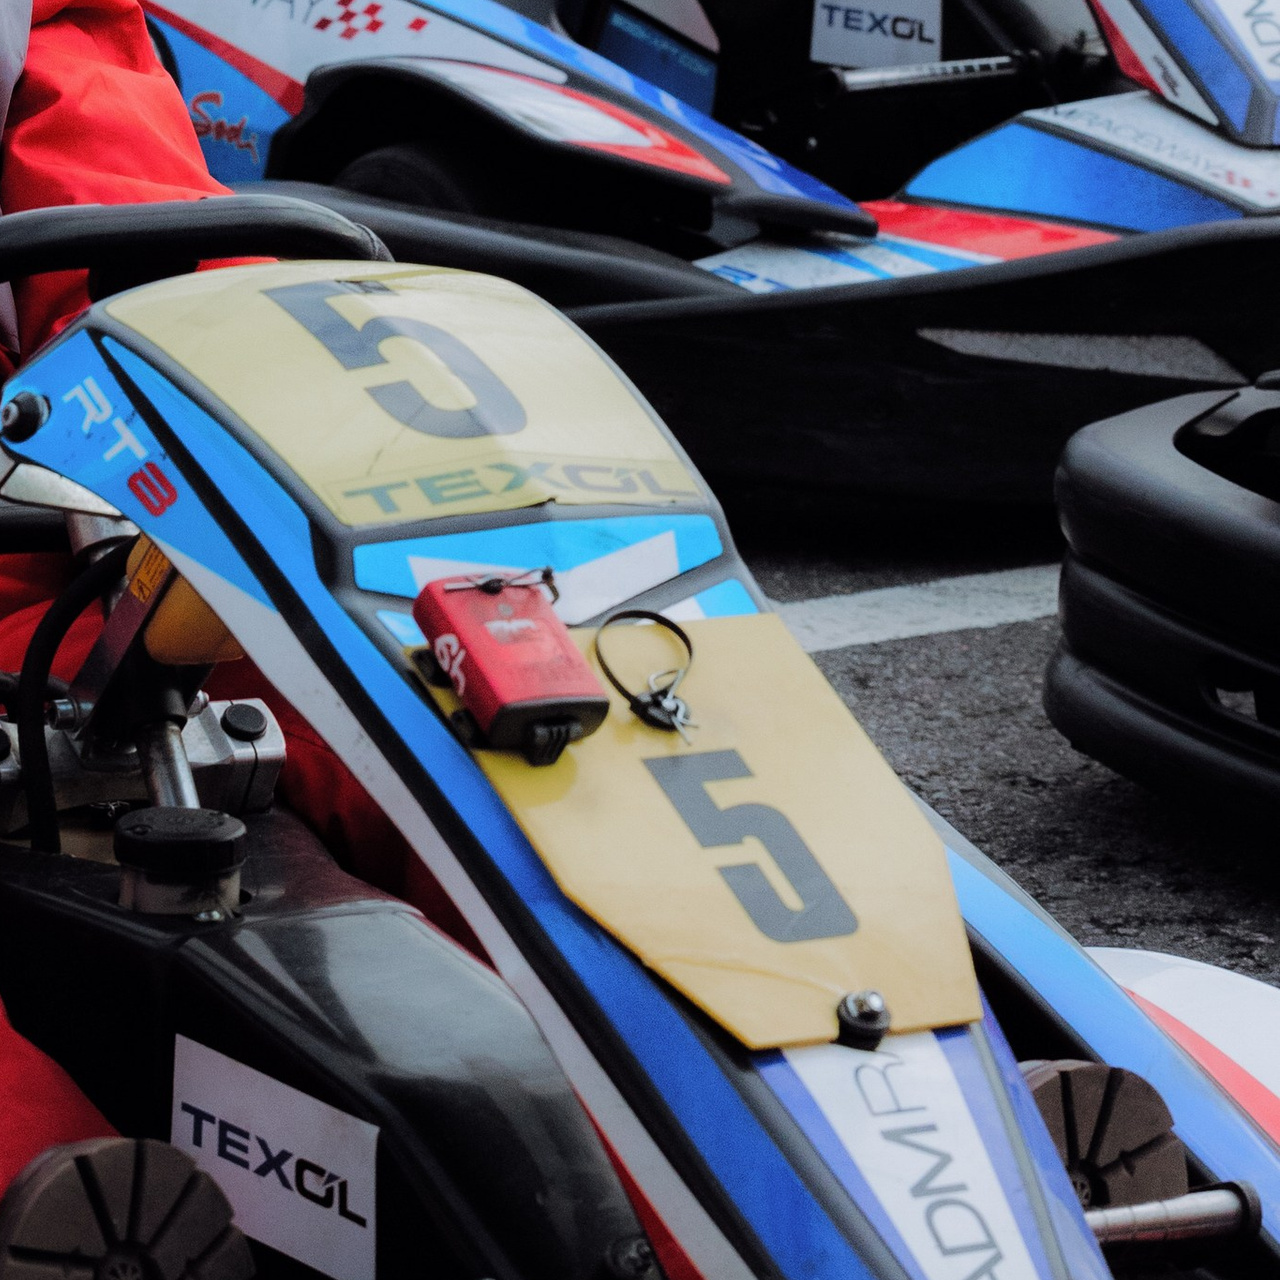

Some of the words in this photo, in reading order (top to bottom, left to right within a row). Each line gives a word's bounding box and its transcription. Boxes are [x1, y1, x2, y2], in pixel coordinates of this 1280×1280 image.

[821, 3, 935, 44] TEXOL
[262, 280, 528, 440] 5
[343, 462, 702, 517] TEXOL
[642, 749, 860, 943] 5
[180, 1101, 367, 1229] TEXOL
